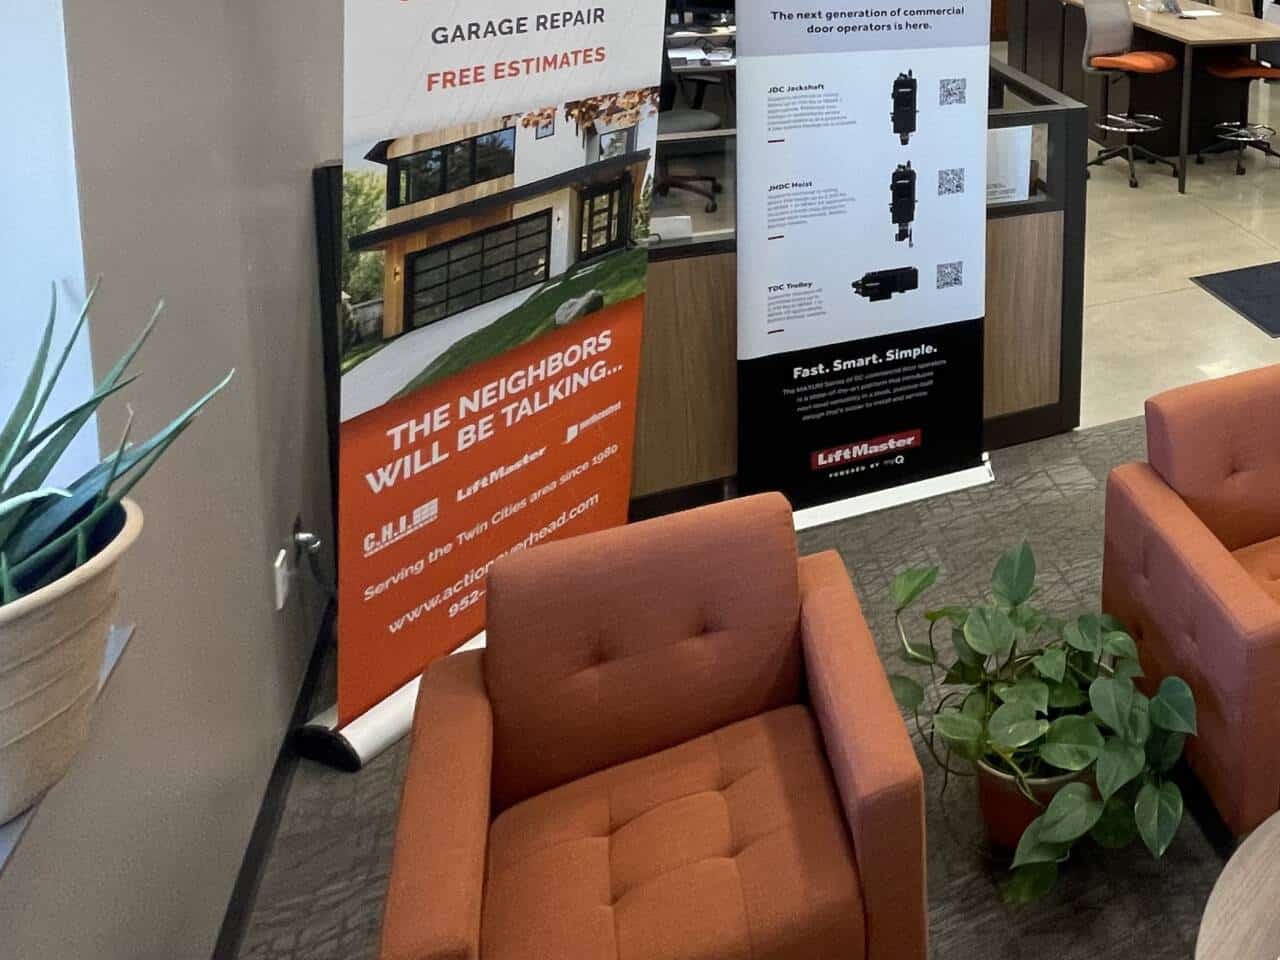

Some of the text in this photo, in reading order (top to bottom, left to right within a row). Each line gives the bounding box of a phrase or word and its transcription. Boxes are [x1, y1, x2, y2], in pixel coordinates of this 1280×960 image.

[431, 7, 604, 44] GARAGE REPAIR
[770, 7, 965, 20] The next generation of commercial
[807, 21, 932, 34] door operators is here.
[427, 47, 605, 92] FREE ESTIMATES
[793, 343, 938, 379] Fast. Smart. Simple.
[387, 403, 450, 451] THE
[459, 329, 611, 418] NEIGHBORS
[366, 440, 448, 495] WILL
[457, 414, 494, 452] BE
[501, 359, 623, 427] TALKING...
[818, 436, 915, 465] LiftMaster
[456, 446, 547, 501] LiftMaster
[363, 515, 412, 553] C.H.I.
[364, 443, 619, 601] Serving the Twin Cities area since 1980
